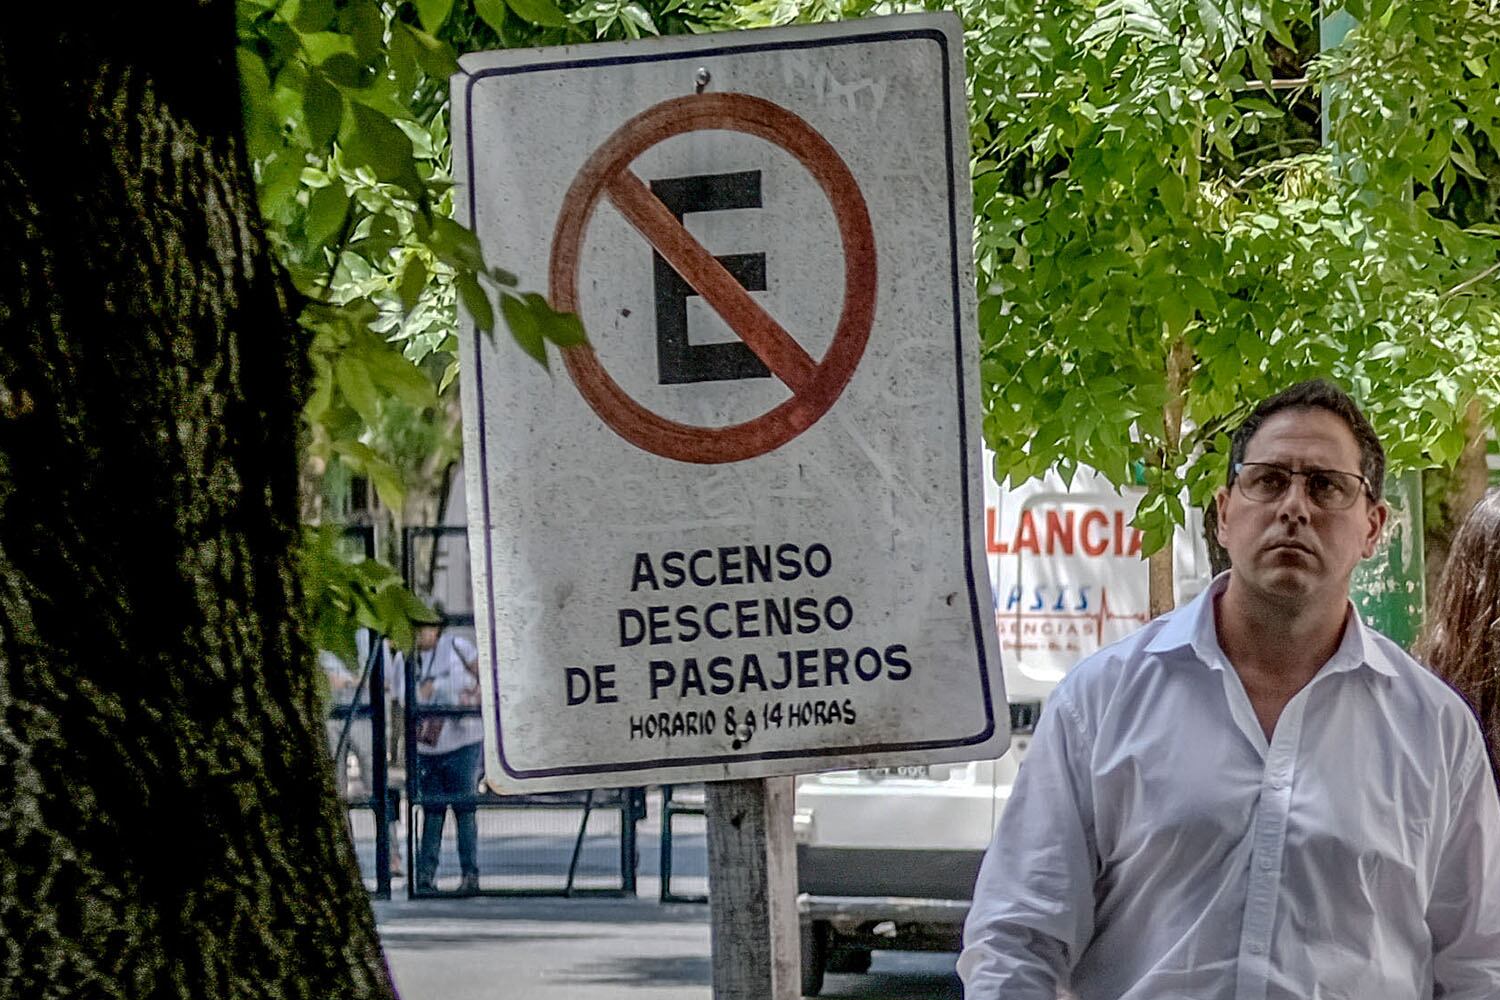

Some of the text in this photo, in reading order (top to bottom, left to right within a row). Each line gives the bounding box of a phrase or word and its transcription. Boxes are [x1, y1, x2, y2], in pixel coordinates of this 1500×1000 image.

[649, 169, 772, 385] E
[630, 542, 832, 592] ASCENSO
[617, 595, 854, 648] DESCENSO
[563, 643, 913, 706] DE PASAJEROS
[629, 709, 716, 741] HORARIO
[763, 702, 784, 730] 14
[788, 698, 857, 729] HORAS
